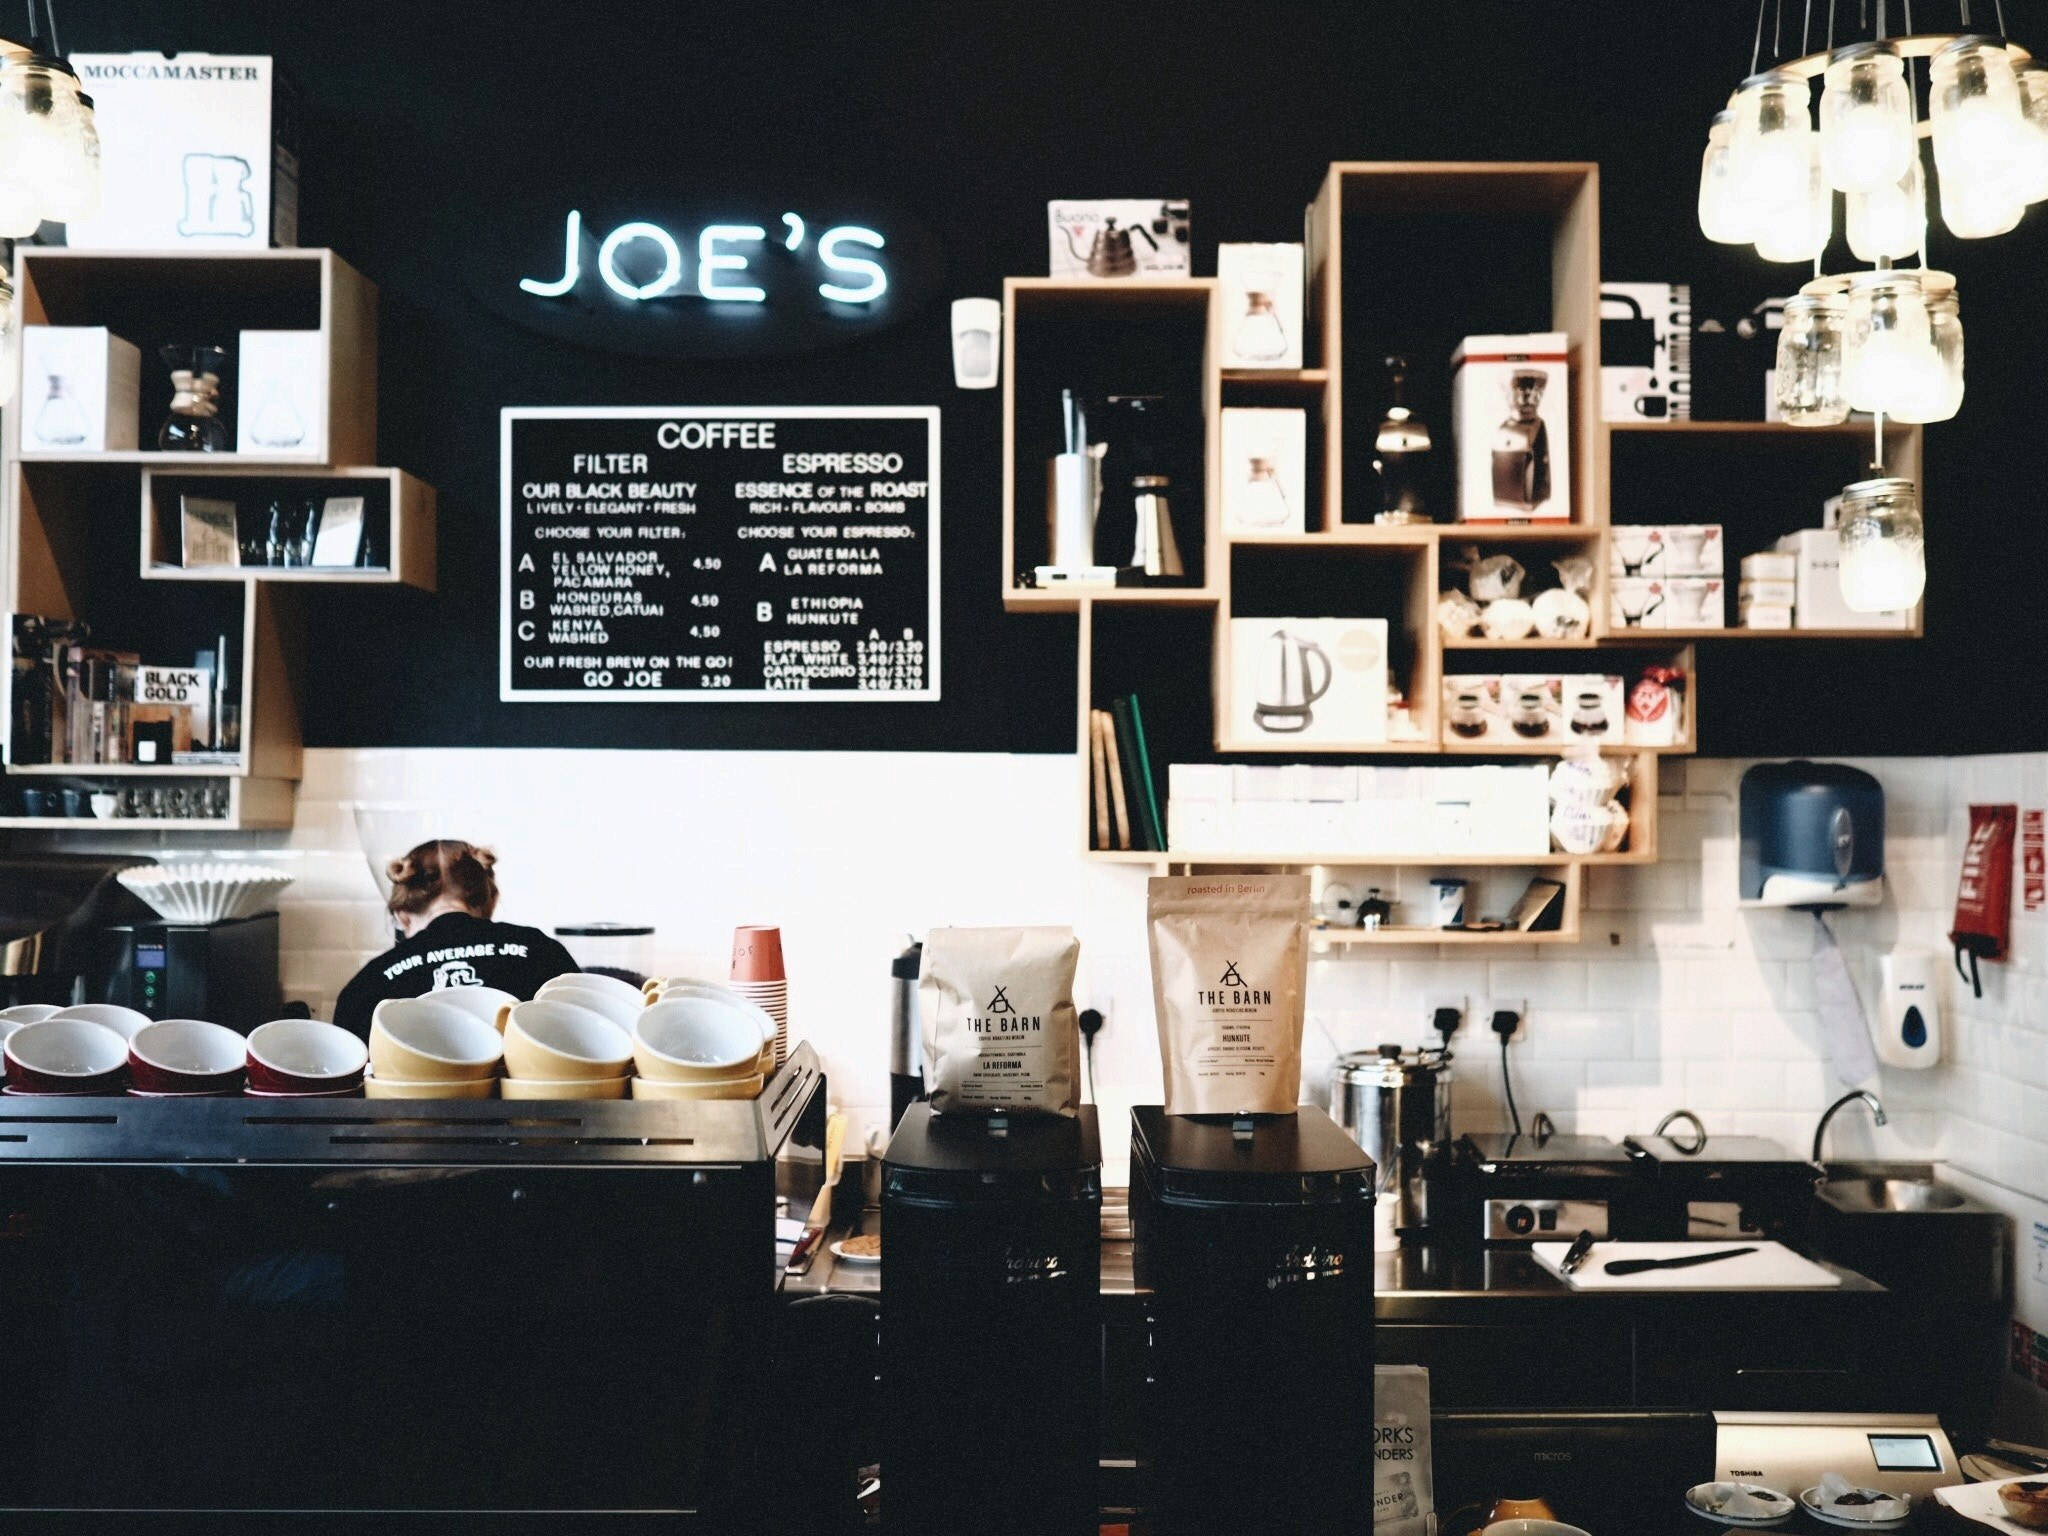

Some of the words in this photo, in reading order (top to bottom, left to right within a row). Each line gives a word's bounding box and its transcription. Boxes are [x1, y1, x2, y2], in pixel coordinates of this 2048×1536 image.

[84, 64, 258, 80] MOCCAMASTER
[519, 209, 888, 303] JOE'S
[657, 422, 776, 449] COFFEE
[574, 454, 647, 474] FILTER
[783, 453, 903, 473] ESPRESSO
[523, 483, 560, 498] OUR
[566, 483, 622, 499] BLACK
[628, 483, 696, 498] BEAUTY
[735, 482, 813, 498] ESSENCE
[817, 486, 835, 498] OF
[840, 486, 863, 498] THE
[871, 482, 927, 497] ROAST
[527, 502, 573, 514] LIVELY
[585, 502, 643, 514] ELEGANT
[654, 502, 696, 514] FRESH
[750, 502, 781, 513] RICH
[792, 501, 852, 513] FLAVOUR
[865, 501, 905, 513] BOMB
[535, 527, 590, 538] CHOOSE
[597, 527, 632, 538] YOUR
[738, 527, 794, 538] CHOOSE
[801, 526, 837, 538] YOUR
[553, 552, 569, 563] EL
[577, 551, 657, 563] SALVADOR
[787, 548, 879, 560] GUATEMALA
[519, 553, 534, 572] A
[693, 558, 721, 569] 4.50
[759, 553, 776, 572] A
[552, 564, 610, 576] YELLOW
[615, 564, 670, 578] HONEY,
[784, 564, 802, 575] LA
[808, 563, 882, 575] REFORMA
[554, 576, 632, 588] PACAMARA
[520, 590, 534, 609] B
[557, 592, 642, 603] HONDURAS
[691, 595, 719, 607] 4.50
[791, 597, 863, 609] ETHIOPIA
[757, 602, 772, 622] B
[787, 612, 858, 624] HUNKUTE
[518, 621, 535, 641] C
[553, 620, 603, 631] KENYA
[548, 631, 608, 644] WASHED
[690, 626, 720, 638] 4.50
[870, 629, 879, 640] A
[904, 628, 913, 640] B
[764, 641, 841, 653] ESPRESSO
[524, 656, 554, 668] OUR
[559, 656, 601, 668] FRESH
[606, 656, 645, 668] BREW
[649, 656, 669, 668] ON
[676, 656, 700, 668] THE
[764, 653, 797, 665] FLAT
[802, 653, 848, 665] WHITE
[763, 665, 856, 677] CAPPUCCINO
[146, 672, 198, 687] BLACK
[584, 671, 613, 687] GO
[624, 671, 662, 687] JOE
[765, 678, 810, 689] LATTE
[145, 686, 187, 701] GOLD
[1187, 884, 1223, 895] roasted
[1225, 884, 1235, 893] in
[1237, 884, 1265, 893] Berlin
[383, 955, 424, 981] YOUR
[426, 943, 495, 963] AVERAGE
[498, 943, 528, 958] JOE
[1198, 990, 1225, 1005] THE
[1232, 990, 1272, 1005] BARN
[966, 1017, 992, 1033] THE
[1000, 1015, 1041, 1032] BARN
[1222, 1034, 1250, 1043] HUNKUTE
[983, 1061, 990, 1070] LA
[992, 1060, 1022, 1069] REFORMA
